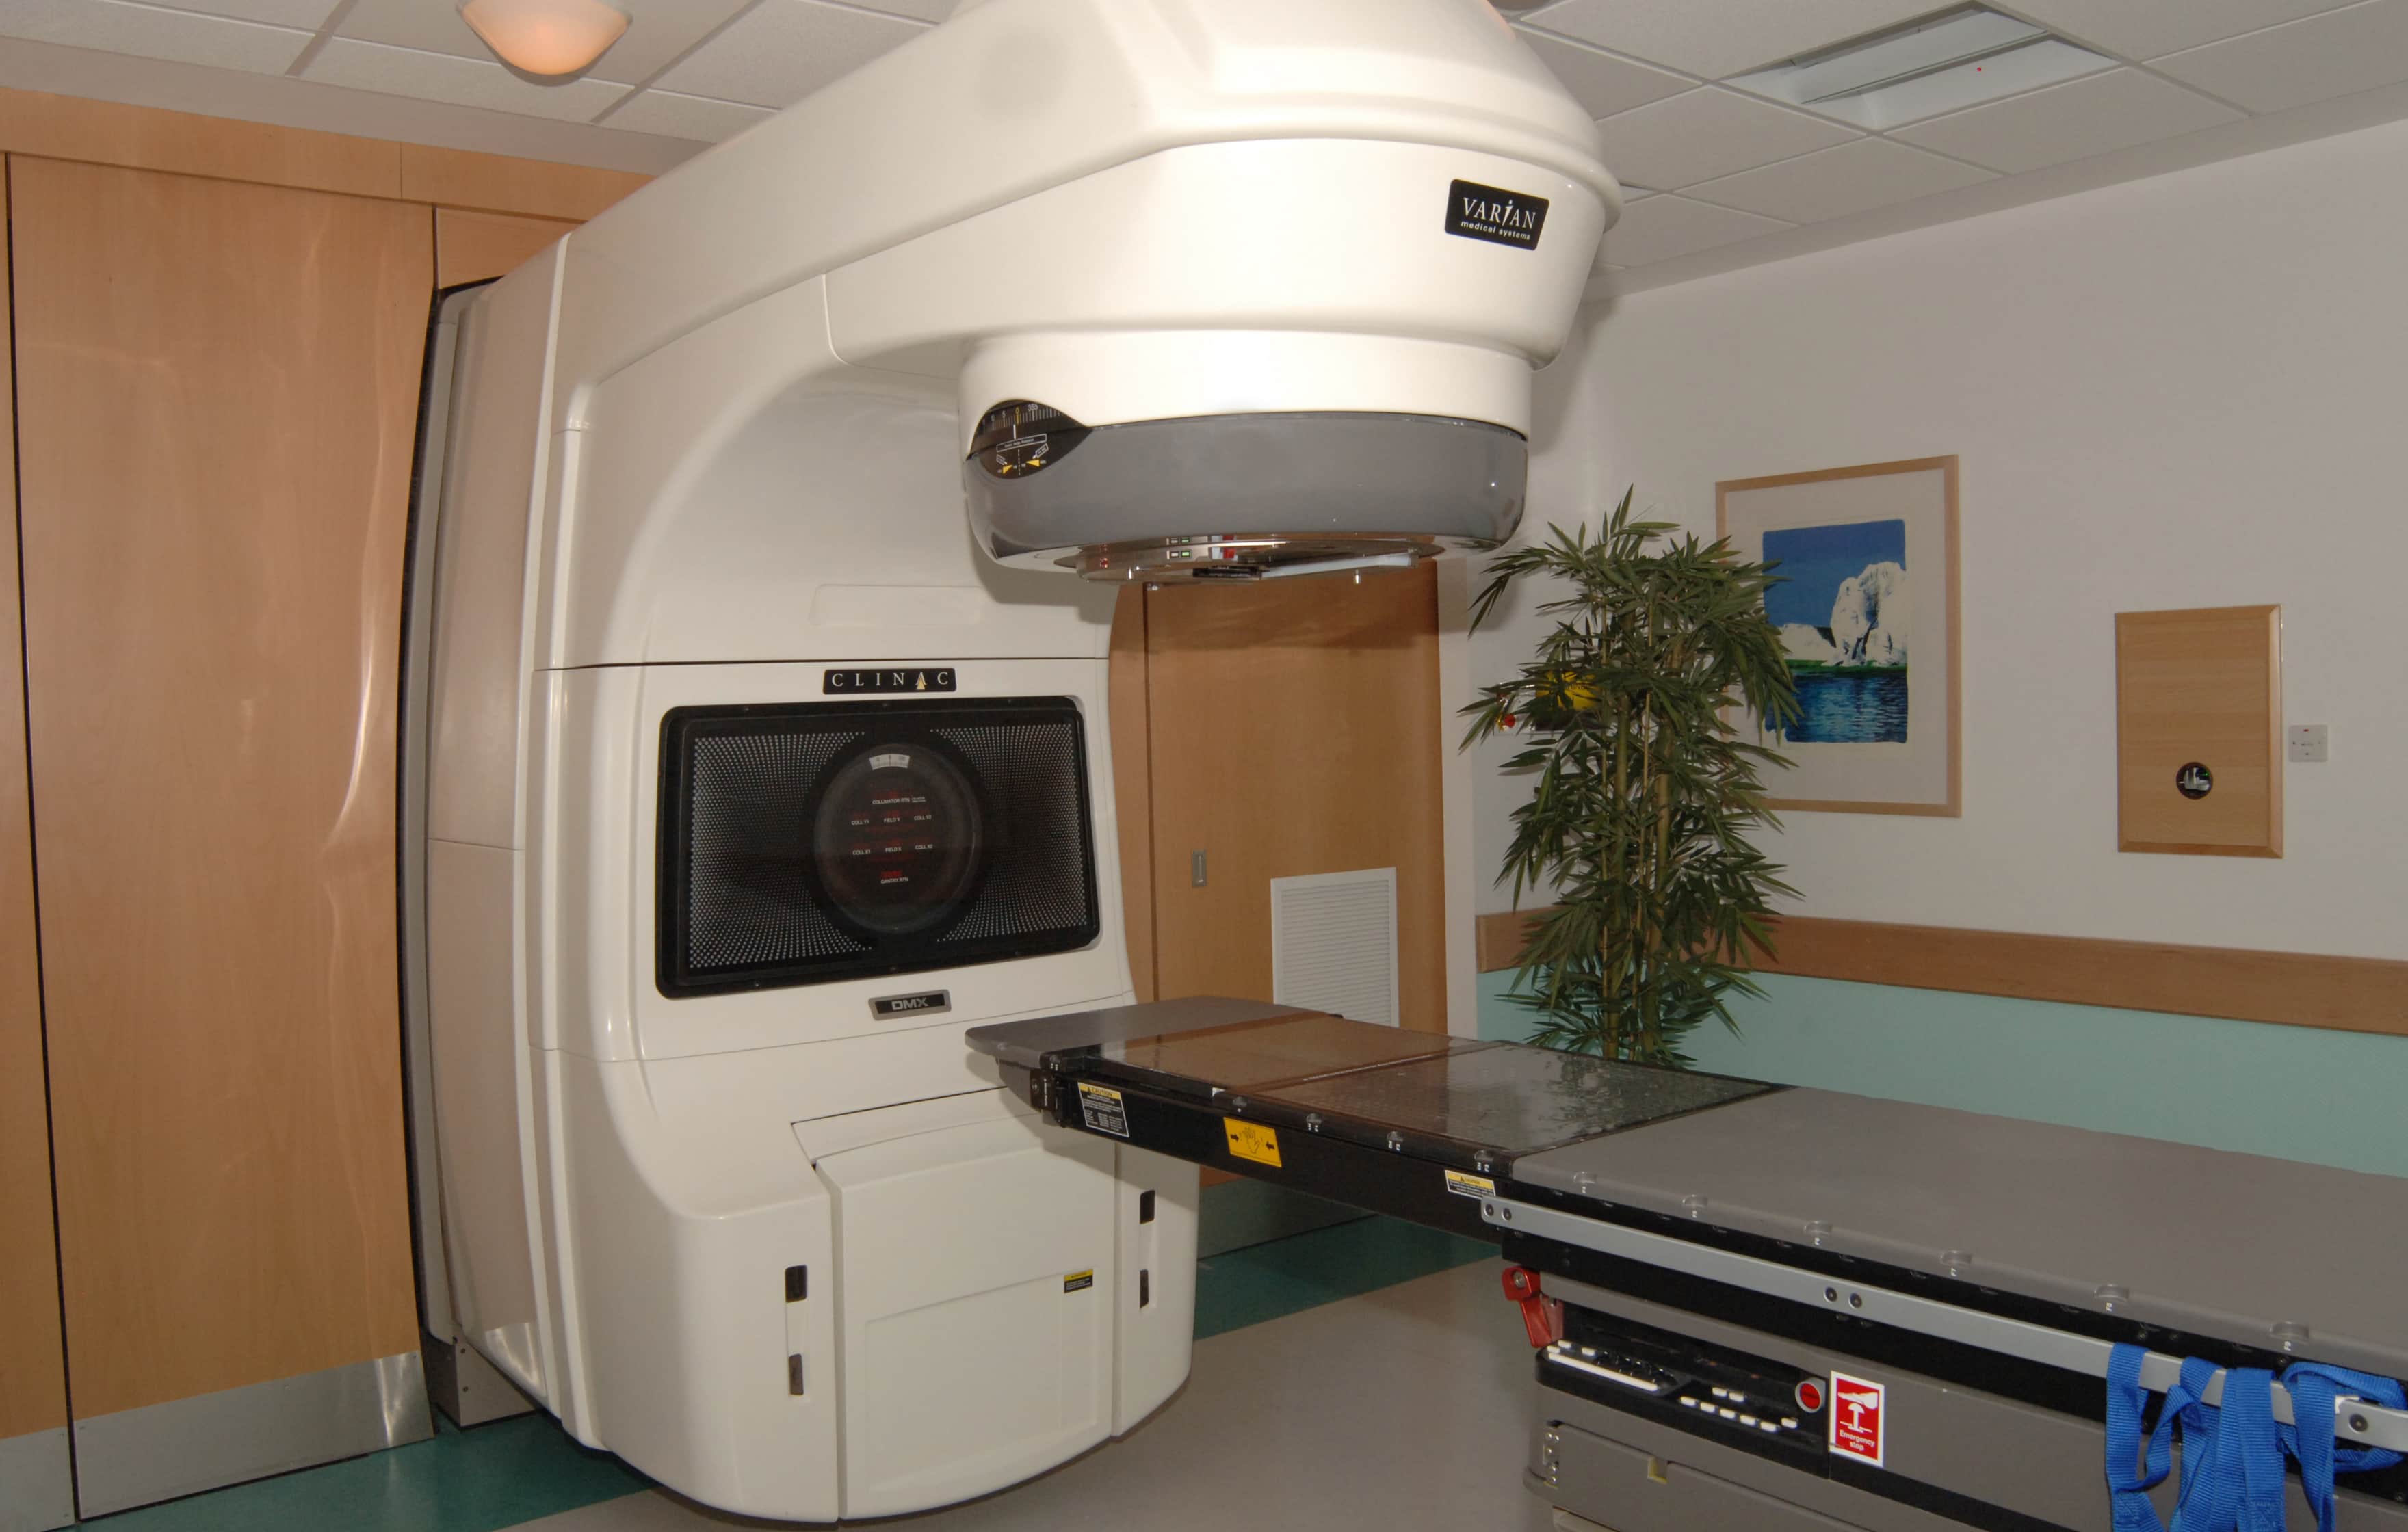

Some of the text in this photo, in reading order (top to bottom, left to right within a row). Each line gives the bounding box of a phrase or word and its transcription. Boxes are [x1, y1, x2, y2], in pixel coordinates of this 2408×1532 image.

[1461, 220, 1531, 241] medical systems
[831, 672, 949, 691] CLINAC
[891, 997, 929, 1011] DMX
[1839, 1429, 1876, 1448] Emergency
[1849, 1441, 1865, 1451] stop
